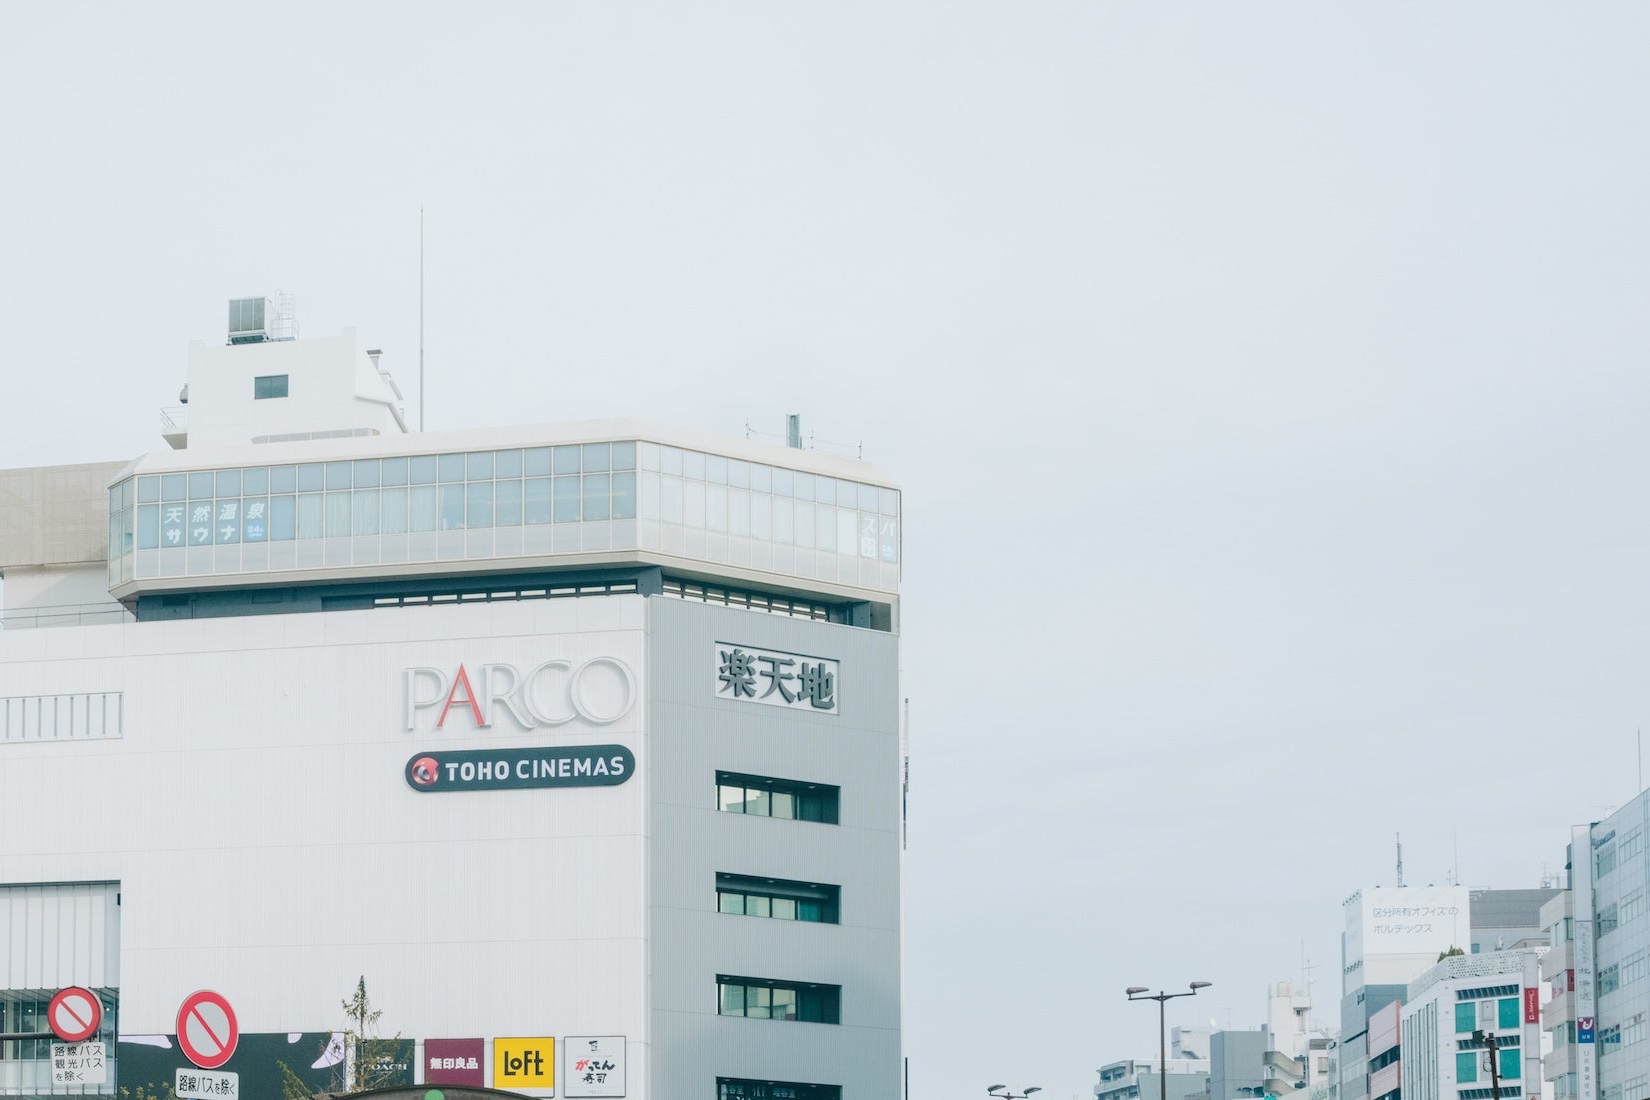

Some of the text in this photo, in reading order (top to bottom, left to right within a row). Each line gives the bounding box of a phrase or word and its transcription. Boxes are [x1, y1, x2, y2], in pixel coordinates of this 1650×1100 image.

[164, 502, 265, 524] 天然温泉
[166, 525, 236, 544] サウナ
[718, 648, 836, 710] 楽天地
[405, 655, 637, 733] PARCO
[445, 755, 625, 782] TOHO CINEMAS
[54, 1045, 103, 1057] 路線バス
[54, 1058, 103, 1069] 観光バス
[430, 1057, 478, 1070] 無印良品
[574, 1059, 615, 1072] がってん
[55, 1071, 85, 1082] を除く
[582, 1073, 607, 1084] 寿司
[179, 1074, 235, 1096] 路線バスを除く
